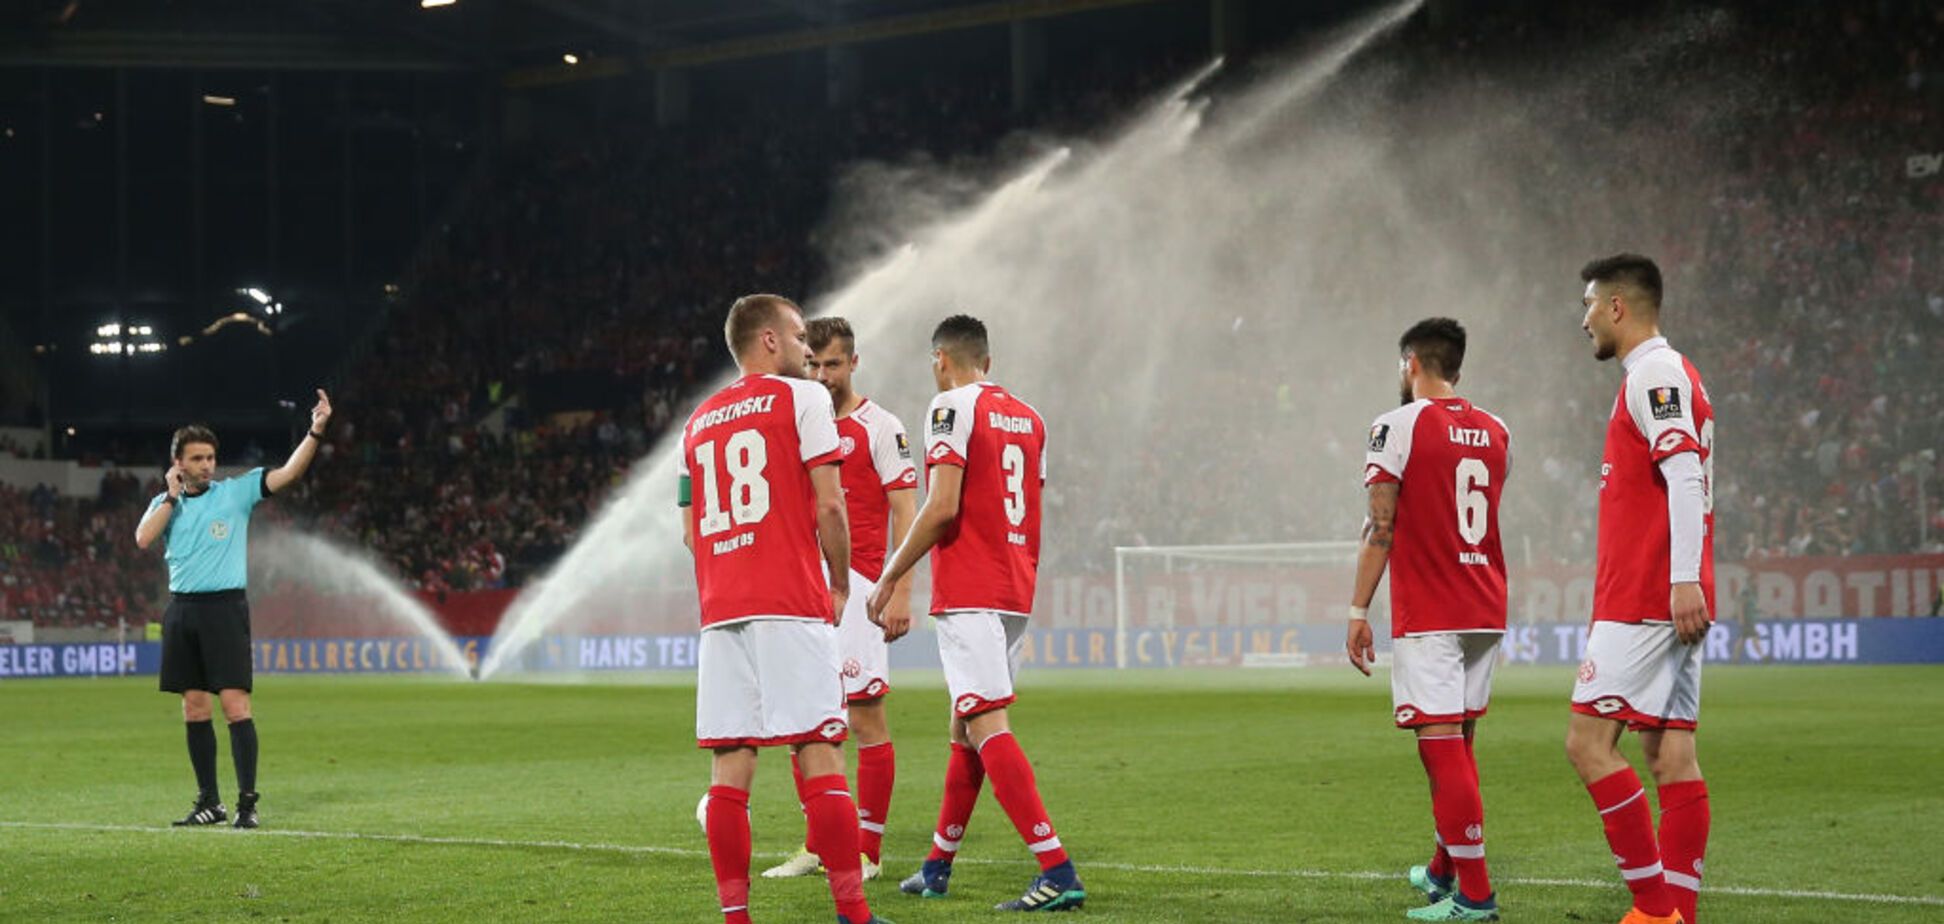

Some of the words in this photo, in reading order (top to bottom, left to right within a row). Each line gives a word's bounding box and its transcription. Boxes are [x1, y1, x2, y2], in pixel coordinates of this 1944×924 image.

[1448, 425, 1490, 447] LATZA
[694, 428, 770, 538] 18
[1002, 443, 1026, 527] 3
[1455, 457, 1489, 546] 6
[62, 644, 136, 674] GMBH
[578, 635, 648, 667] HANS
[1745, 622, 1858, 661] GMBH
